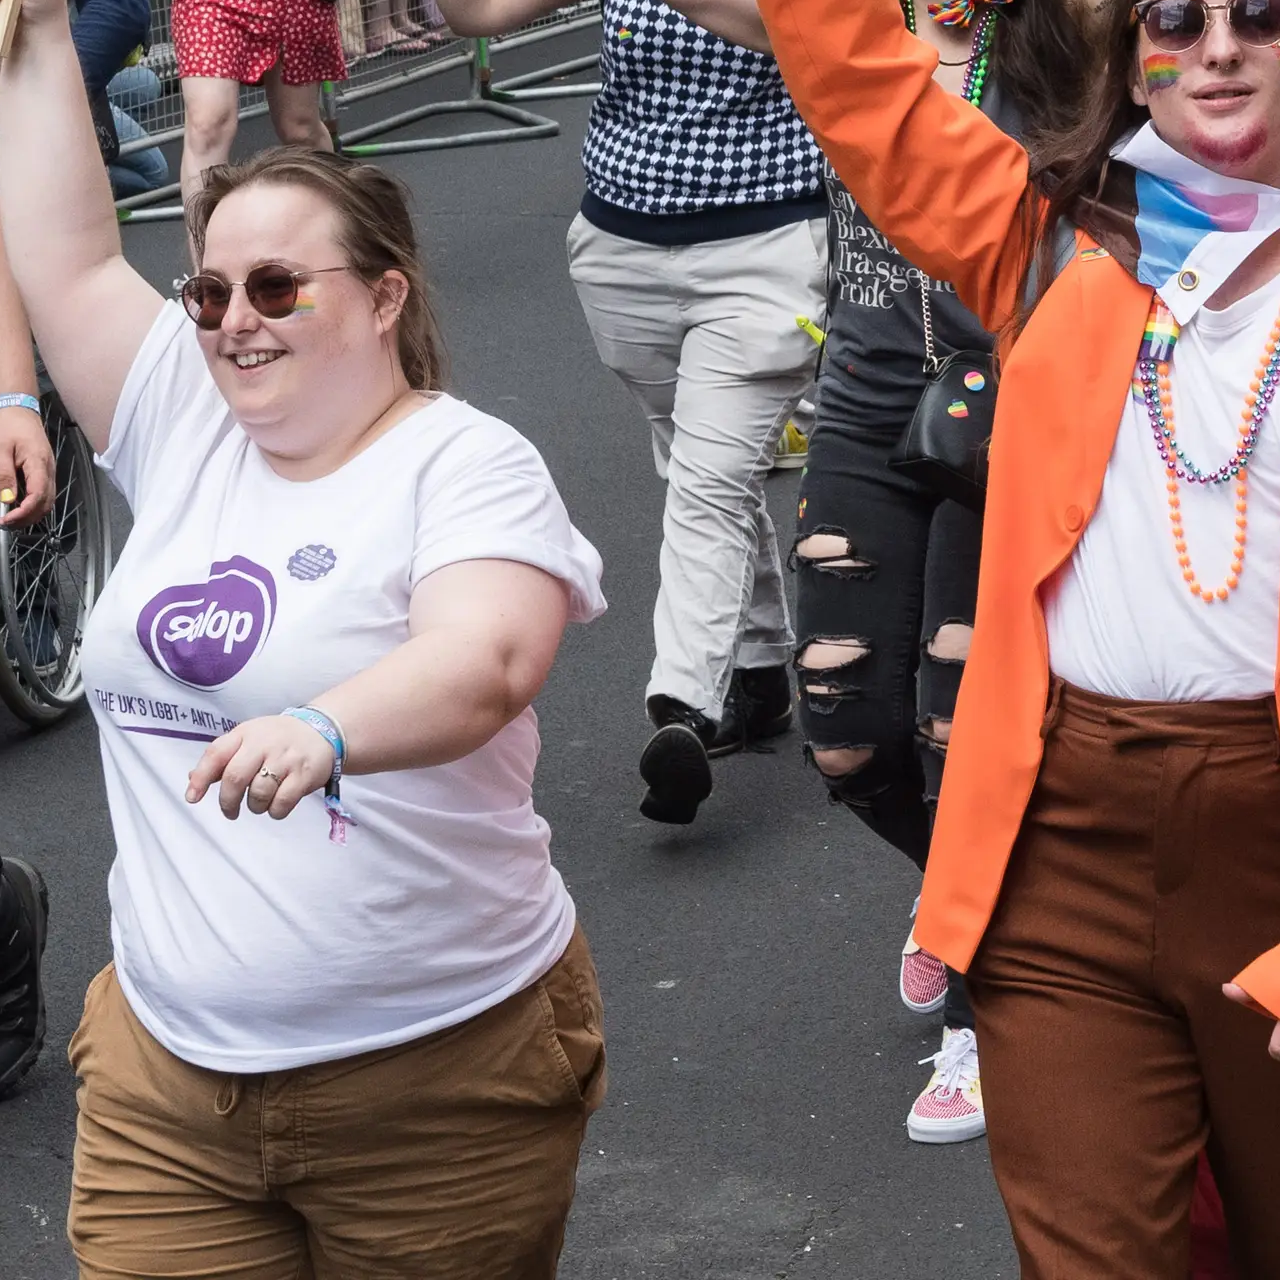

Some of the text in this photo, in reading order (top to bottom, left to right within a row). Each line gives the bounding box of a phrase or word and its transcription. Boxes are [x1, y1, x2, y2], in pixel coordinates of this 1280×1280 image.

[836, 272, 895, 310] Pride
[95, 689, 115, 712] THE
[117, 694, 148, 716] UK'S
[149, 700, 188, 722] LGBT+
